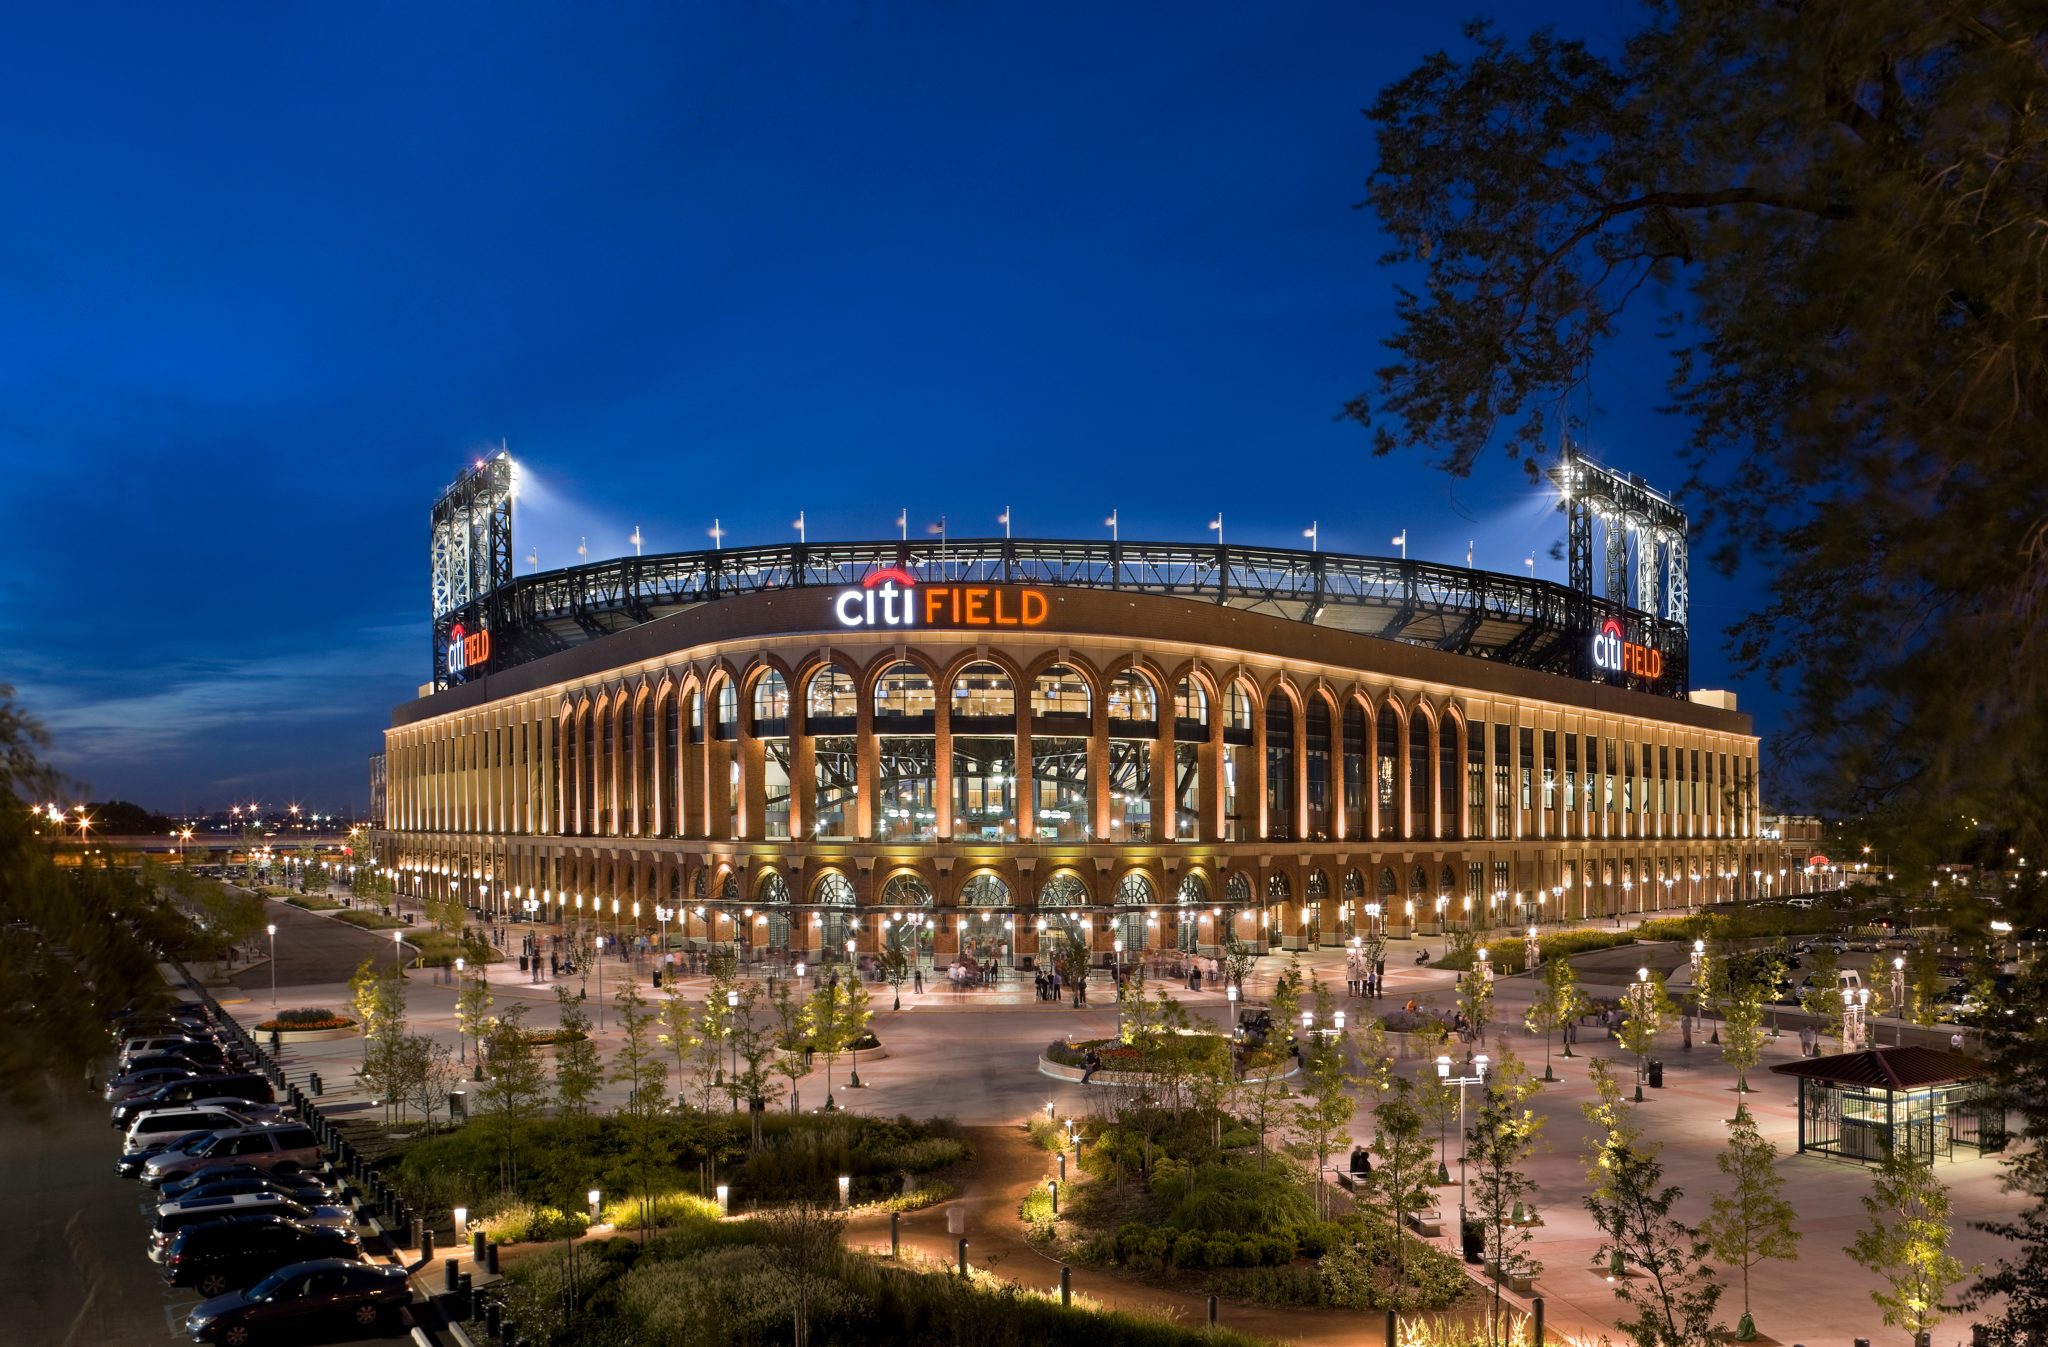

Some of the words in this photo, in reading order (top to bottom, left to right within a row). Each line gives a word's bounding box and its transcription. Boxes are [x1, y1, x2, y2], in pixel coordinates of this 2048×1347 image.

[836, 580, 914, 626] citi
[926, 588, 1048, 625] FIELD
[464, 629, 489, 667] FIELD
[1594, 631, 1621, 670] citi
[1624, 642, 1660, 678] FIELD
